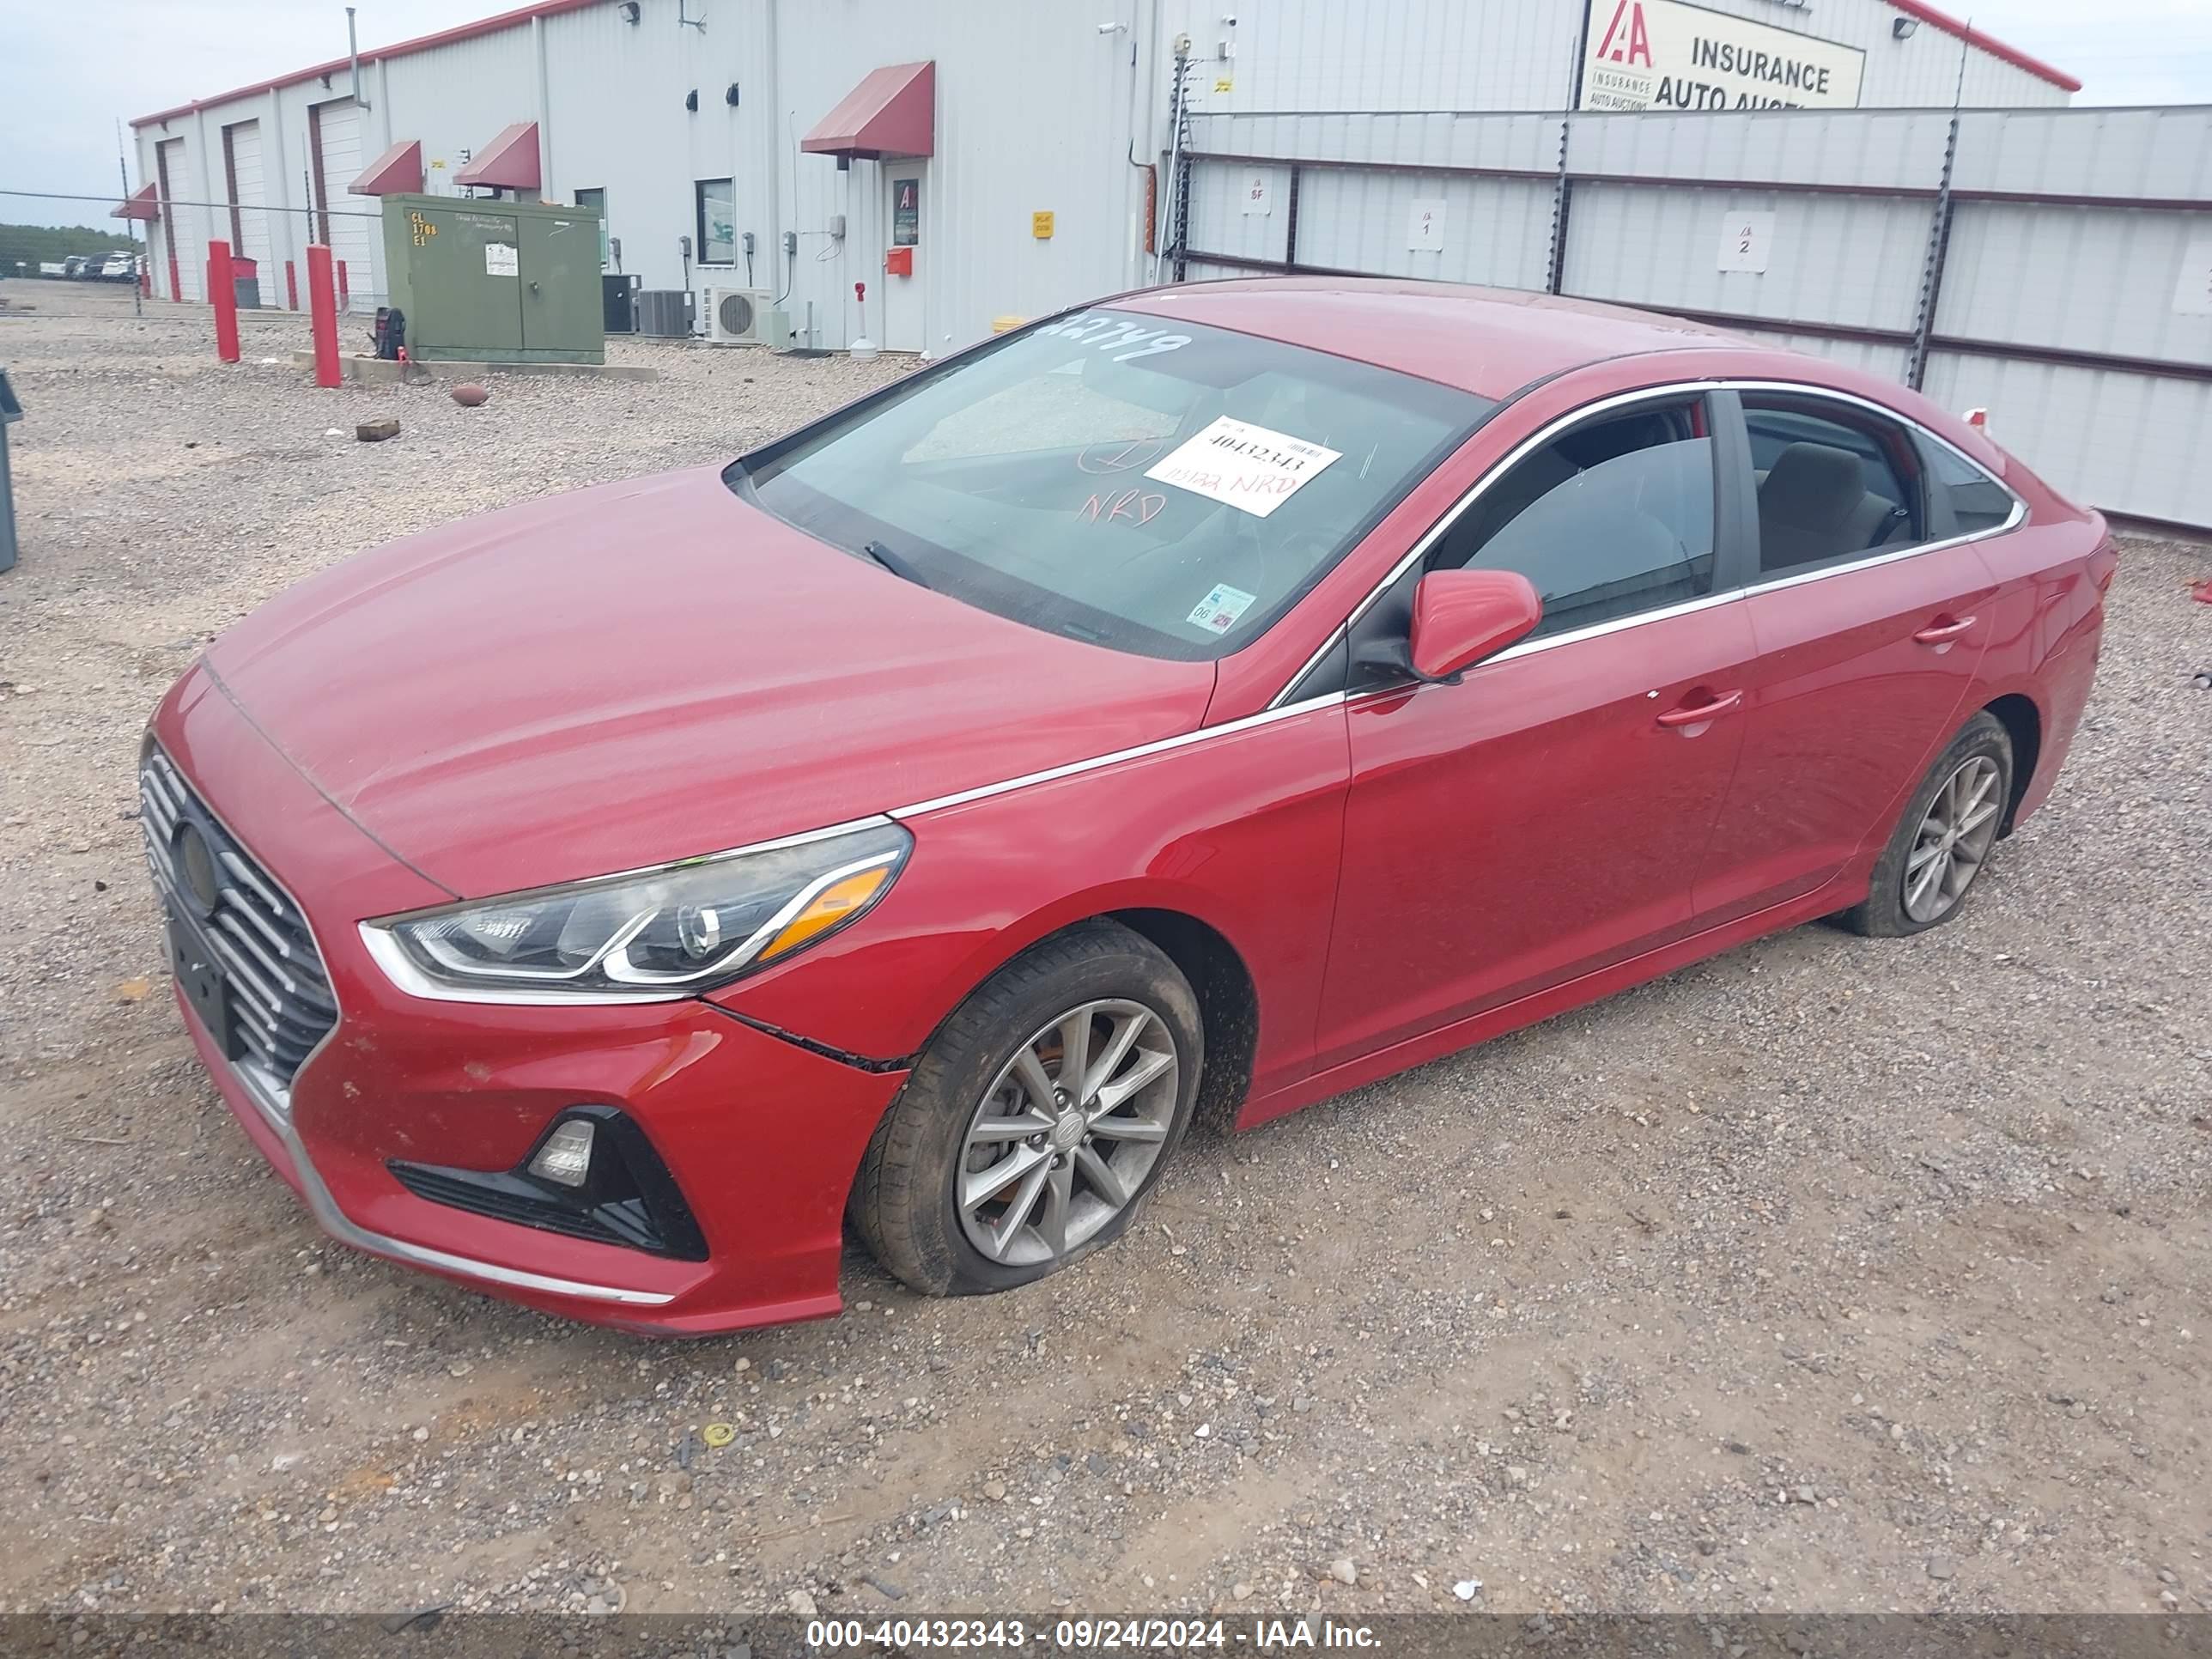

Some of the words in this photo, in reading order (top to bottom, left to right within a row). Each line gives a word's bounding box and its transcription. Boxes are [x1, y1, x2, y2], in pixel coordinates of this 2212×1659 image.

[1692, 37, 1830, 94] INSURANCE
[1655, 76, 1726, 110] AUTO
[1739, 240, 1750, 253] 2
[1209, 434, 1305, 471] 40432343
[1230, 475, 1297, 495] NRD
[1075, 489, 1167, 528] NRD
